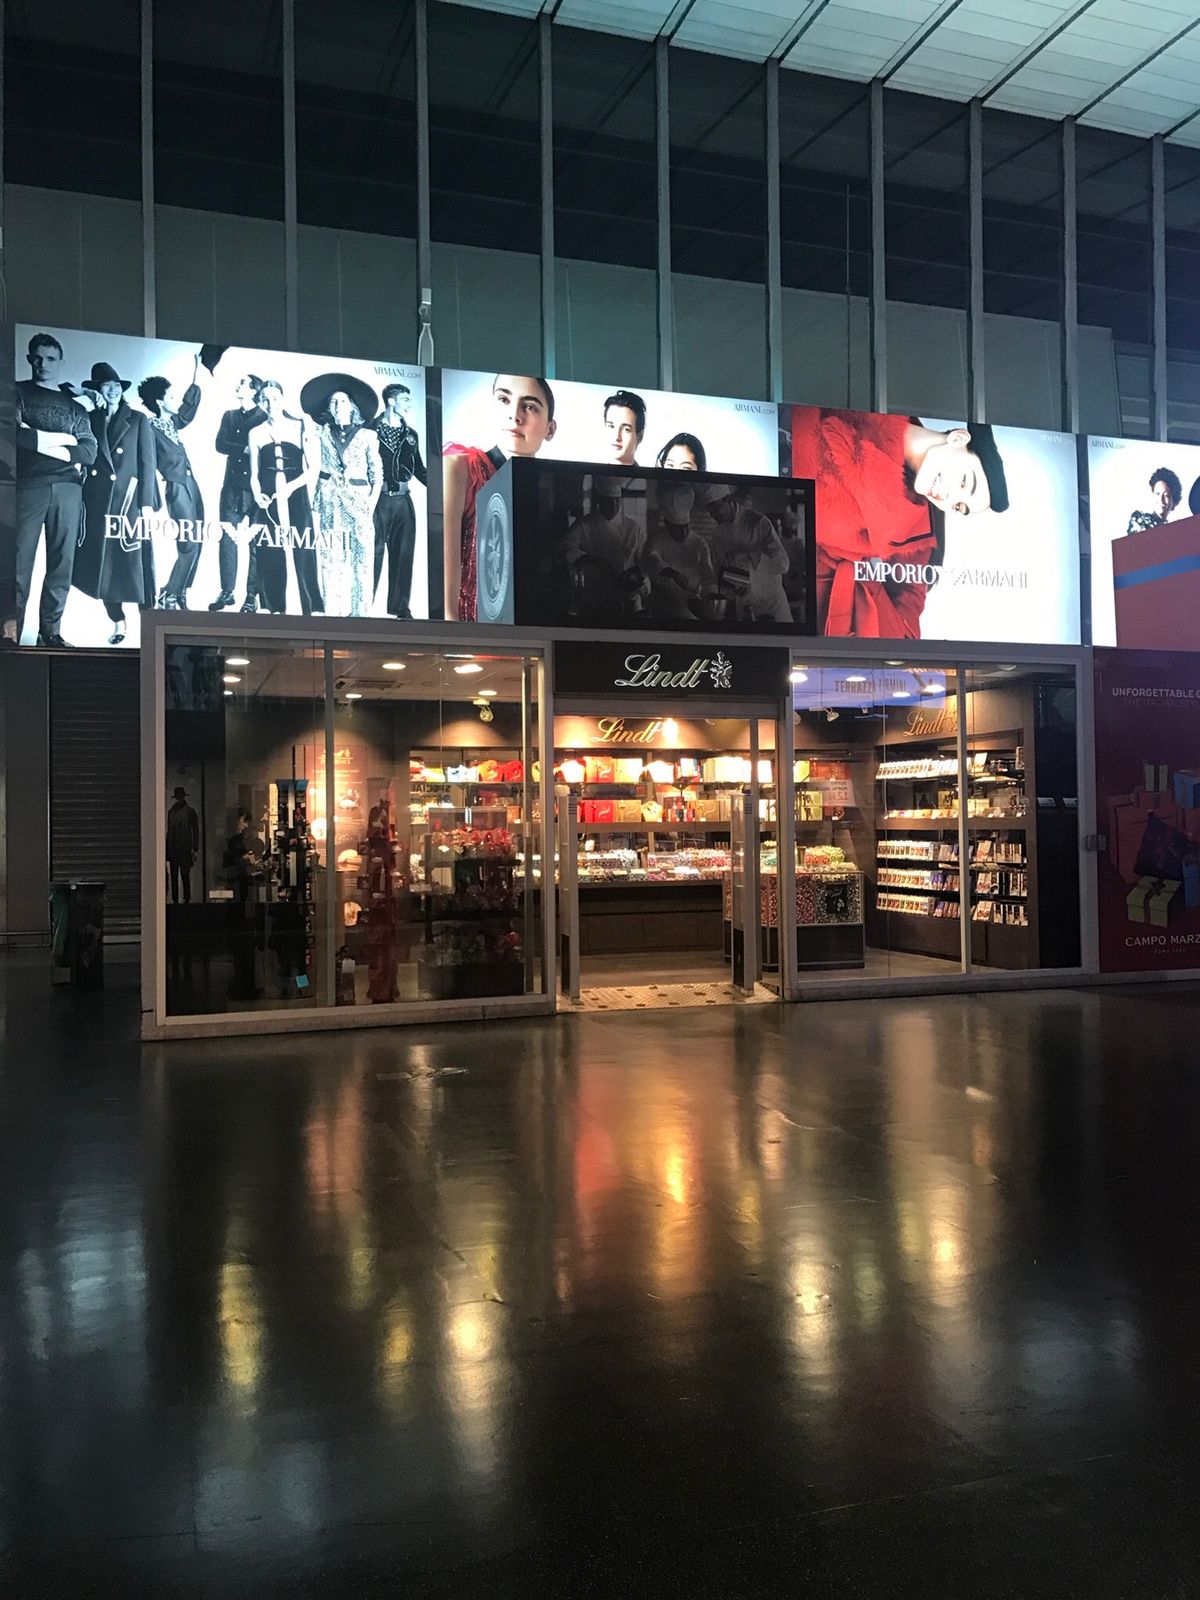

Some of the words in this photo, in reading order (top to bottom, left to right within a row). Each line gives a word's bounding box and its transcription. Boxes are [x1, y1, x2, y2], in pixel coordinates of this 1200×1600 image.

[104, 514, 224, 545] EMPORIO
[256, 523, 352, 551] ARMANI
[854, 561, 937, 585] EMPORIO
[960, 568, 1028, 589] ARMANI
[614, 653, 710, 688] Lindt
[1112, 687, 1194, 699] UNFORGETTABLE
[590, 716, 663, 744] Lindt
[903, 706, 947, 738] Lindt
[1125, 935, 1167, 947] CAMPO
